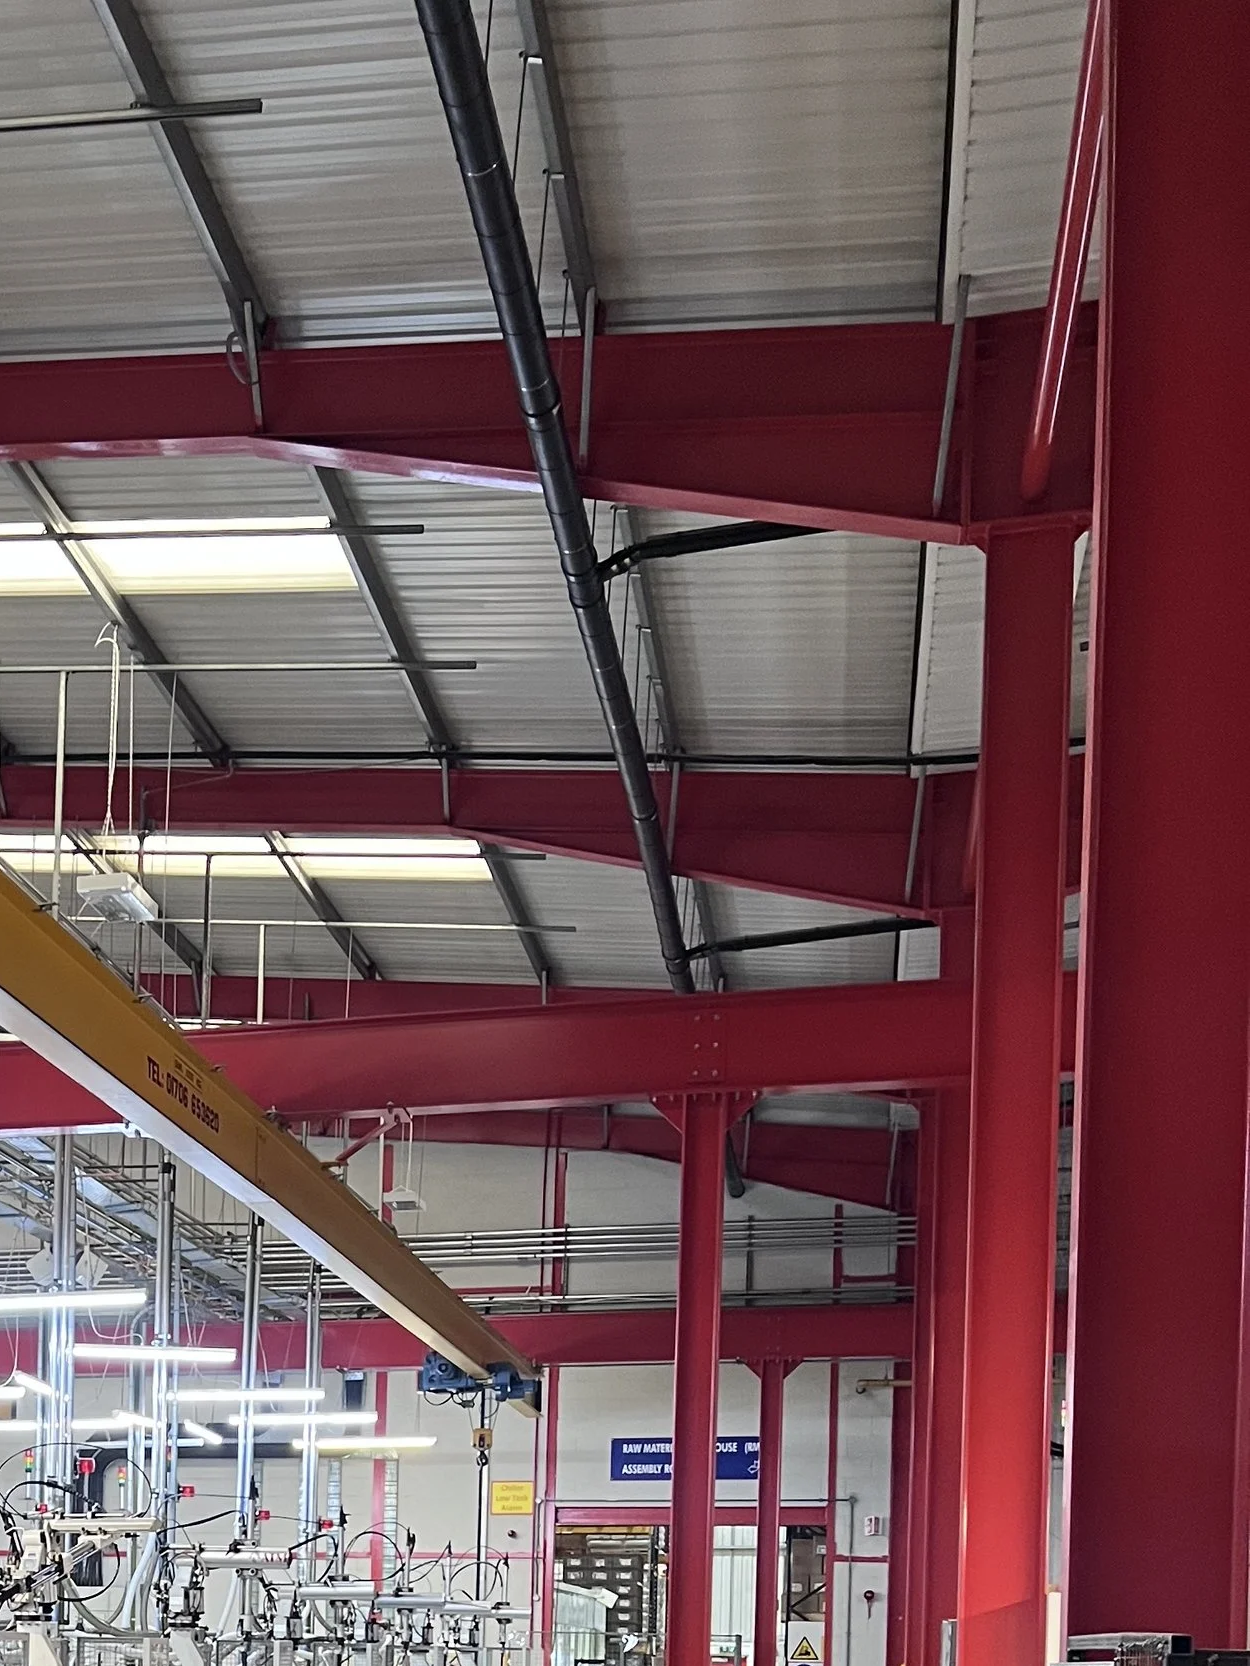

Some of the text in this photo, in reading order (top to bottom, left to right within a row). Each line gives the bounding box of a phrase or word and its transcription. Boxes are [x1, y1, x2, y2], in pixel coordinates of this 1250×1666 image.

[147, 1055, 164, 1088] TEL:
[622, 1443, 641, 1454] RAW
[715, 1442, 738, 1453] OUSE
[622, 1464, 663, 1475] ASSEMBLY
